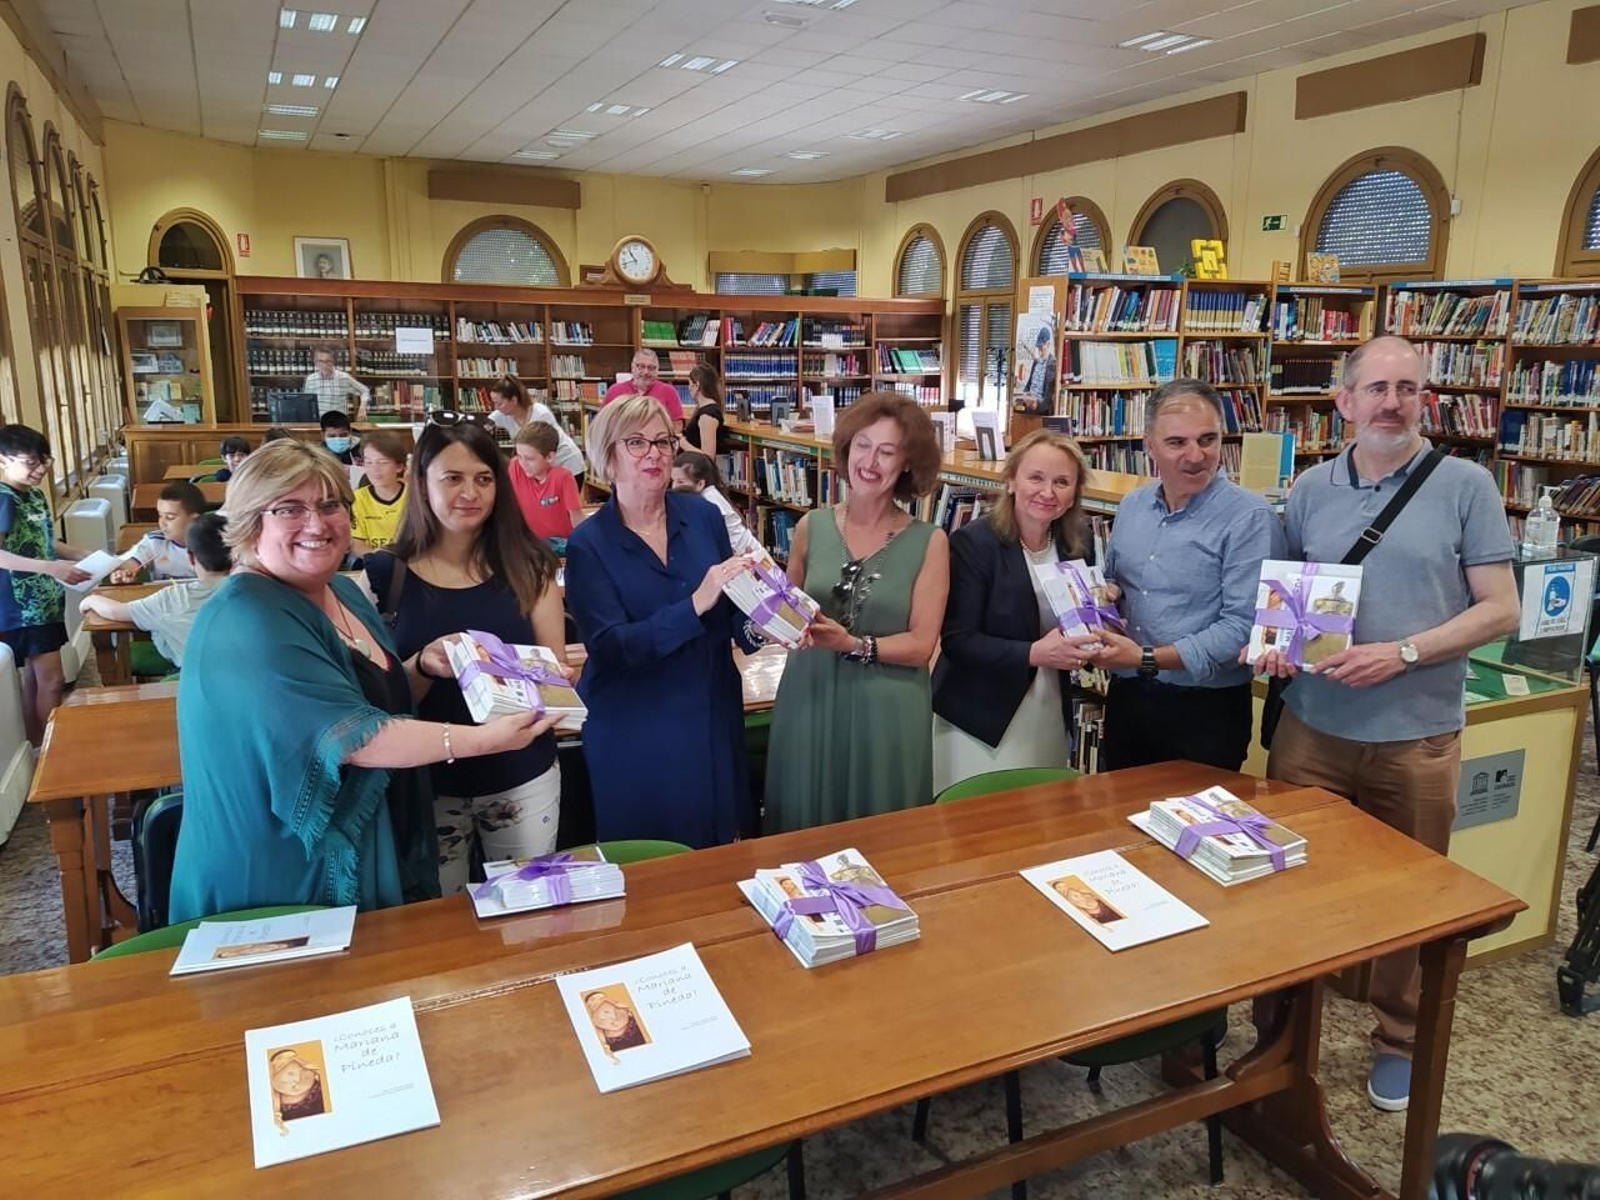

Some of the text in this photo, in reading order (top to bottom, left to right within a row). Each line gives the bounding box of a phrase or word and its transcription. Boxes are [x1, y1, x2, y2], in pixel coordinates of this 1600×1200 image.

[638, 972, 692, 993] Mariana
[663, 987, 676, 996] de
[334, 1031, 400, 1051] Mariana
[341, 1052, 401, 1073] Pineda?
[361, 1047, 378, 1058] de
